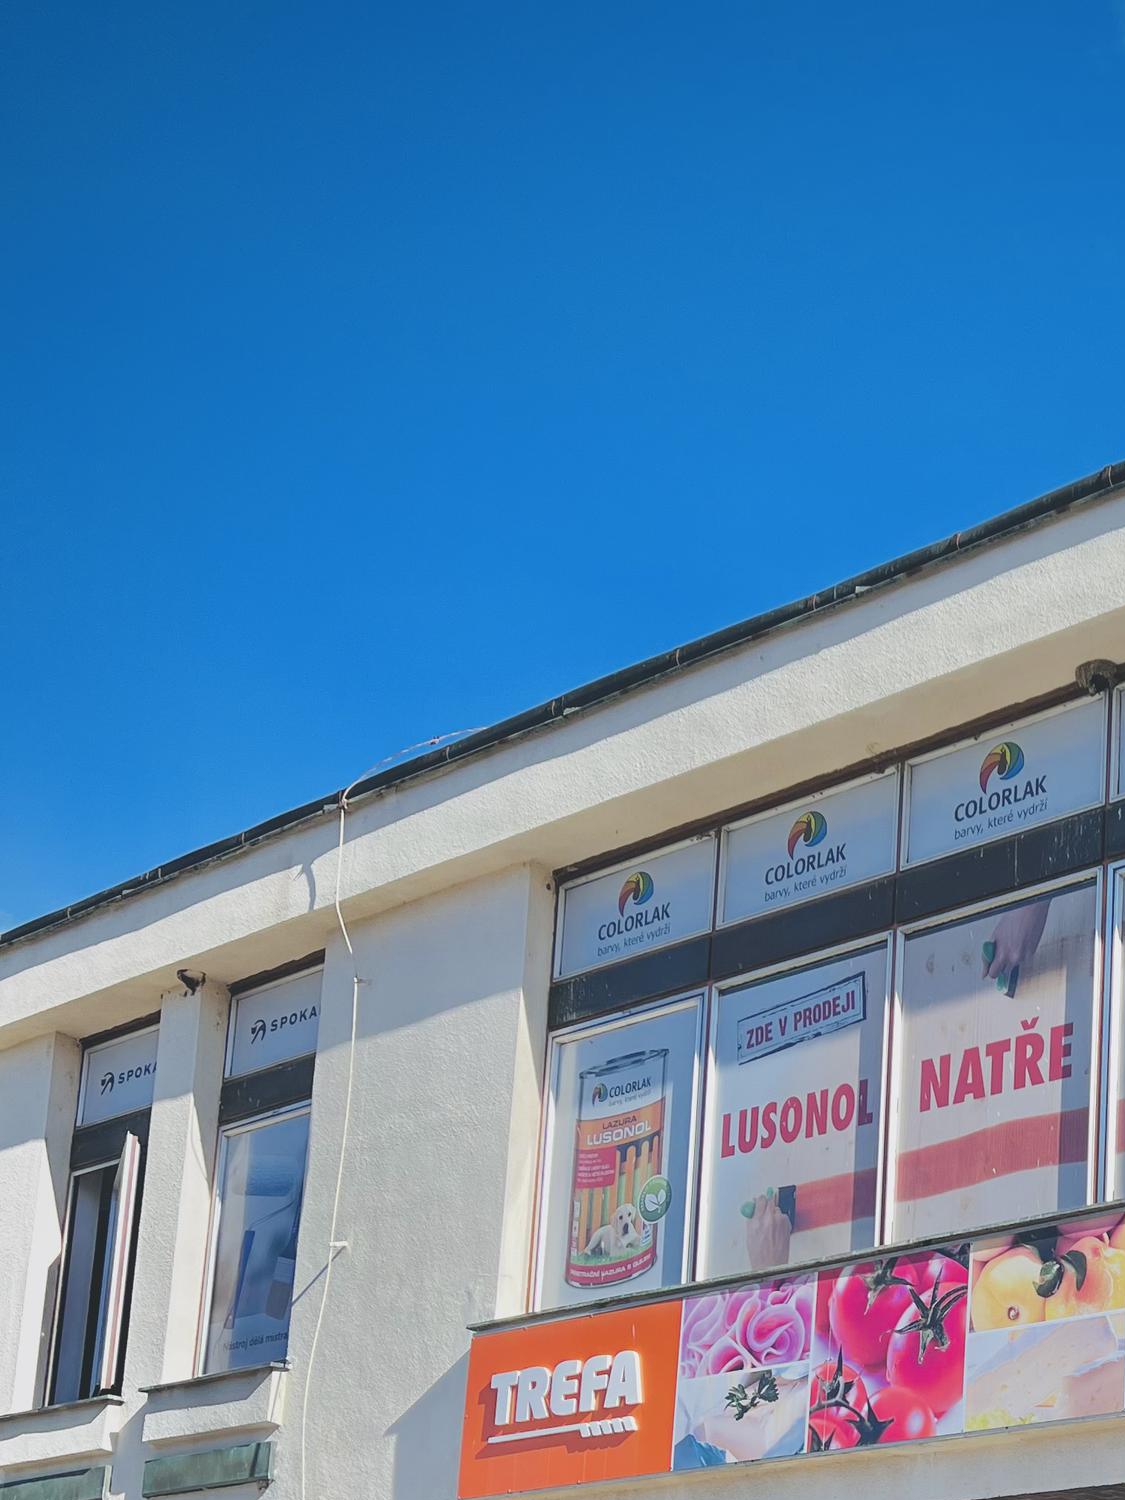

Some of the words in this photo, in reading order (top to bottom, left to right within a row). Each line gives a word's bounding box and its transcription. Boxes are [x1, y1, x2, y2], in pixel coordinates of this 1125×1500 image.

[954, 775, 1047, 822] COLORLAK
[954, 823, 984, 840] barvy,
[987, 810, 1014, 829] které
[1017, 798, 1048, 820] vydrží
[764, 887, 791, 902] barvy,
[794, 875, 817, 893] které
[819, 865, 847, 884] vydrží
[765, 843, 847, 885] COLORLAK
[598, 902, 671, 941] COLORLAK
[270, 1005, 321, 1032] SPOKA
[746, 1021, 774, 1049] ZDE
[778, 1015, 788, 1037] V
[793, 990, 856, 1032] PRODEJI
[919, 1016, 1074, 1113] NATŘE
[609, 1077, 652, 1098] COLORLAK
[586, 1120, 652, 1146] LUSONOL
[602, 1115, 637, 1130] LAZURA
[720, 1078, 873, 1159] LUSONOL
[491, 1350, 643, 1426] TREFA
